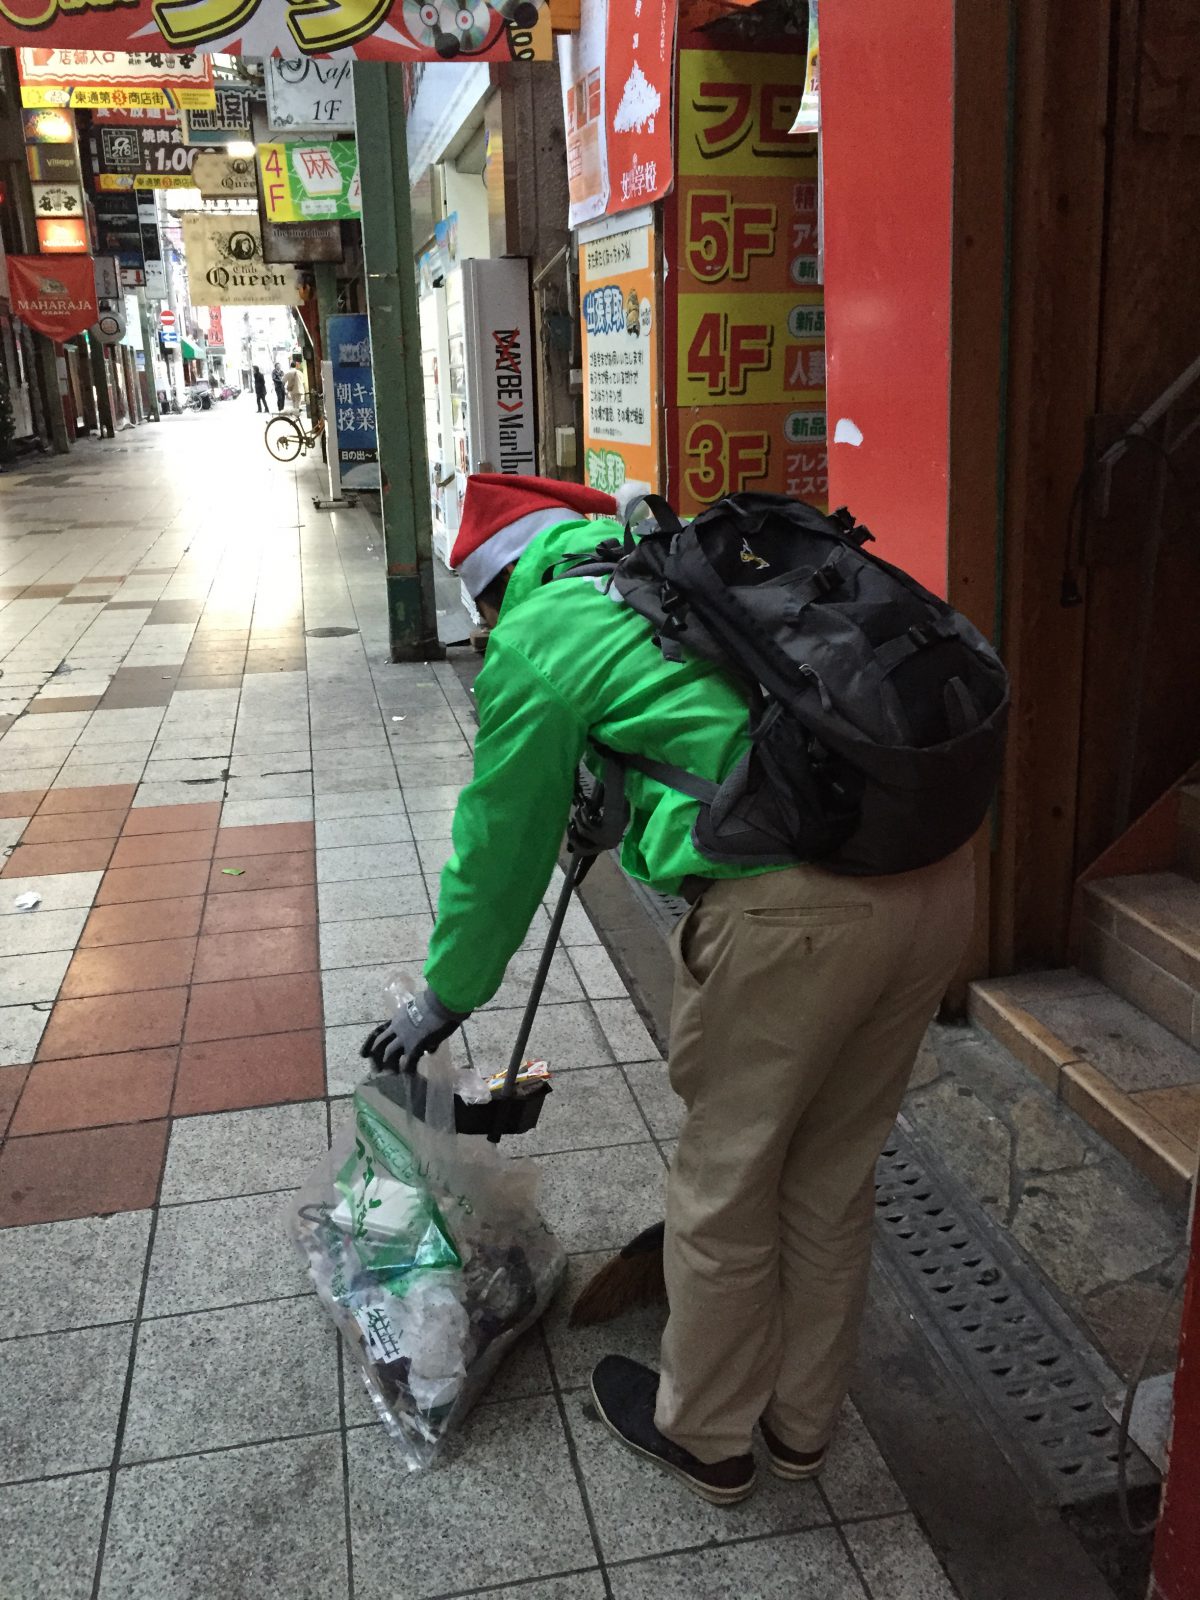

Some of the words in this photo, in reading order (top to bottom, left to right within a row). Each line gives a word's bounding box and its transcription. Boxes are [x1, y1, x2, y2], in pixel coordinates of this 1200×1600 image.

[313, 100, 342, 121] 1F
[687, 189, 777, 282] 5F
[206, 267, 287, 288] Queen
[18, 300, 93, 311] MAHARAJA
[688, 312, 772, 393] 4F
[685, 419, 769, 502] 3F
